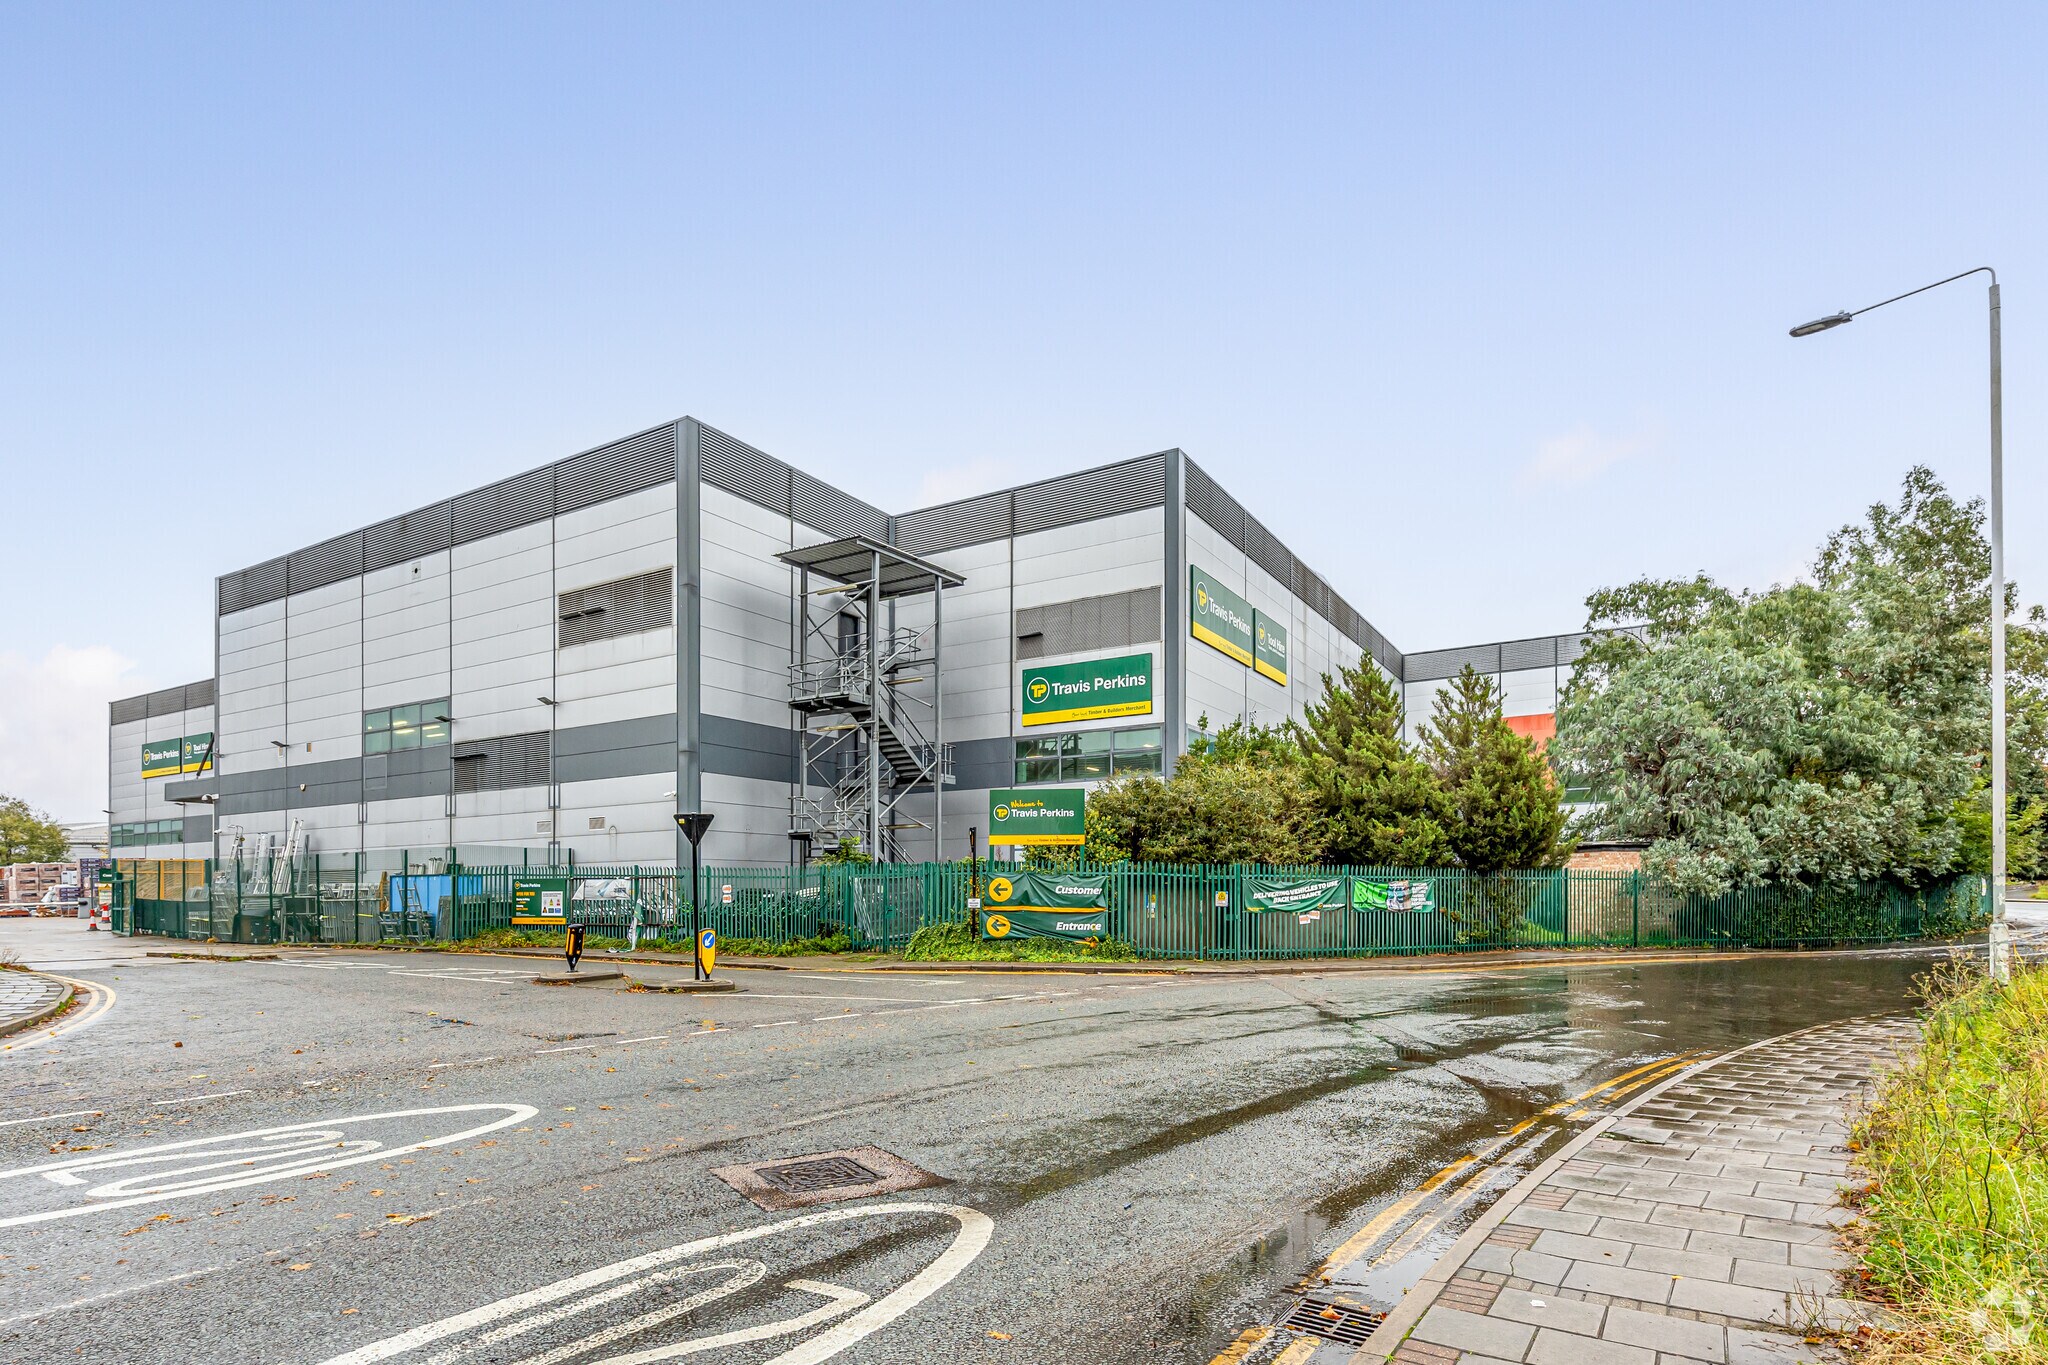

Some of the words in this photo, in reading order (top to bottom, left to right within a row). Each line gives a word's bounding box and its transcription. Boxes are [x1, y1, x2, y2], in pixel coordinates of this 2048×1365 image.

[1208, 597, 1228, 621] Travis
[1228, 610, 1251, 636] Perkins
[1267, 633, 1277, 649] Tool
[1276, 638, 1285, 653] Hire
[1052, 679, 1091, 696] Travis
[1094, 674, 1146, 691] Perkins
[1125, 704, 1146, 712] Merchant
[163, 749, 179, 759] Perkins
[1010, 800, 1036, 808] Welcome
[1011, 809, 1038, 817] Travis
[1040, 808, 1075, 817] Perkins
[1055, 885, 1103, 895] Customer
[1253, 891, 1290, 899] DELIVERING
[1290, 885, 1319, 895] VEHICLES
[1318, 882, 1327, 890] TO
[1327, 880, 1339, 888] USE
[1354, 881, 1389, 904] BIG
[1273, 896, 1290, 904] BACK
[1290, 891, 1322, 901] ENTRANCE
[1055, 922, 1102, 931] Entrance
